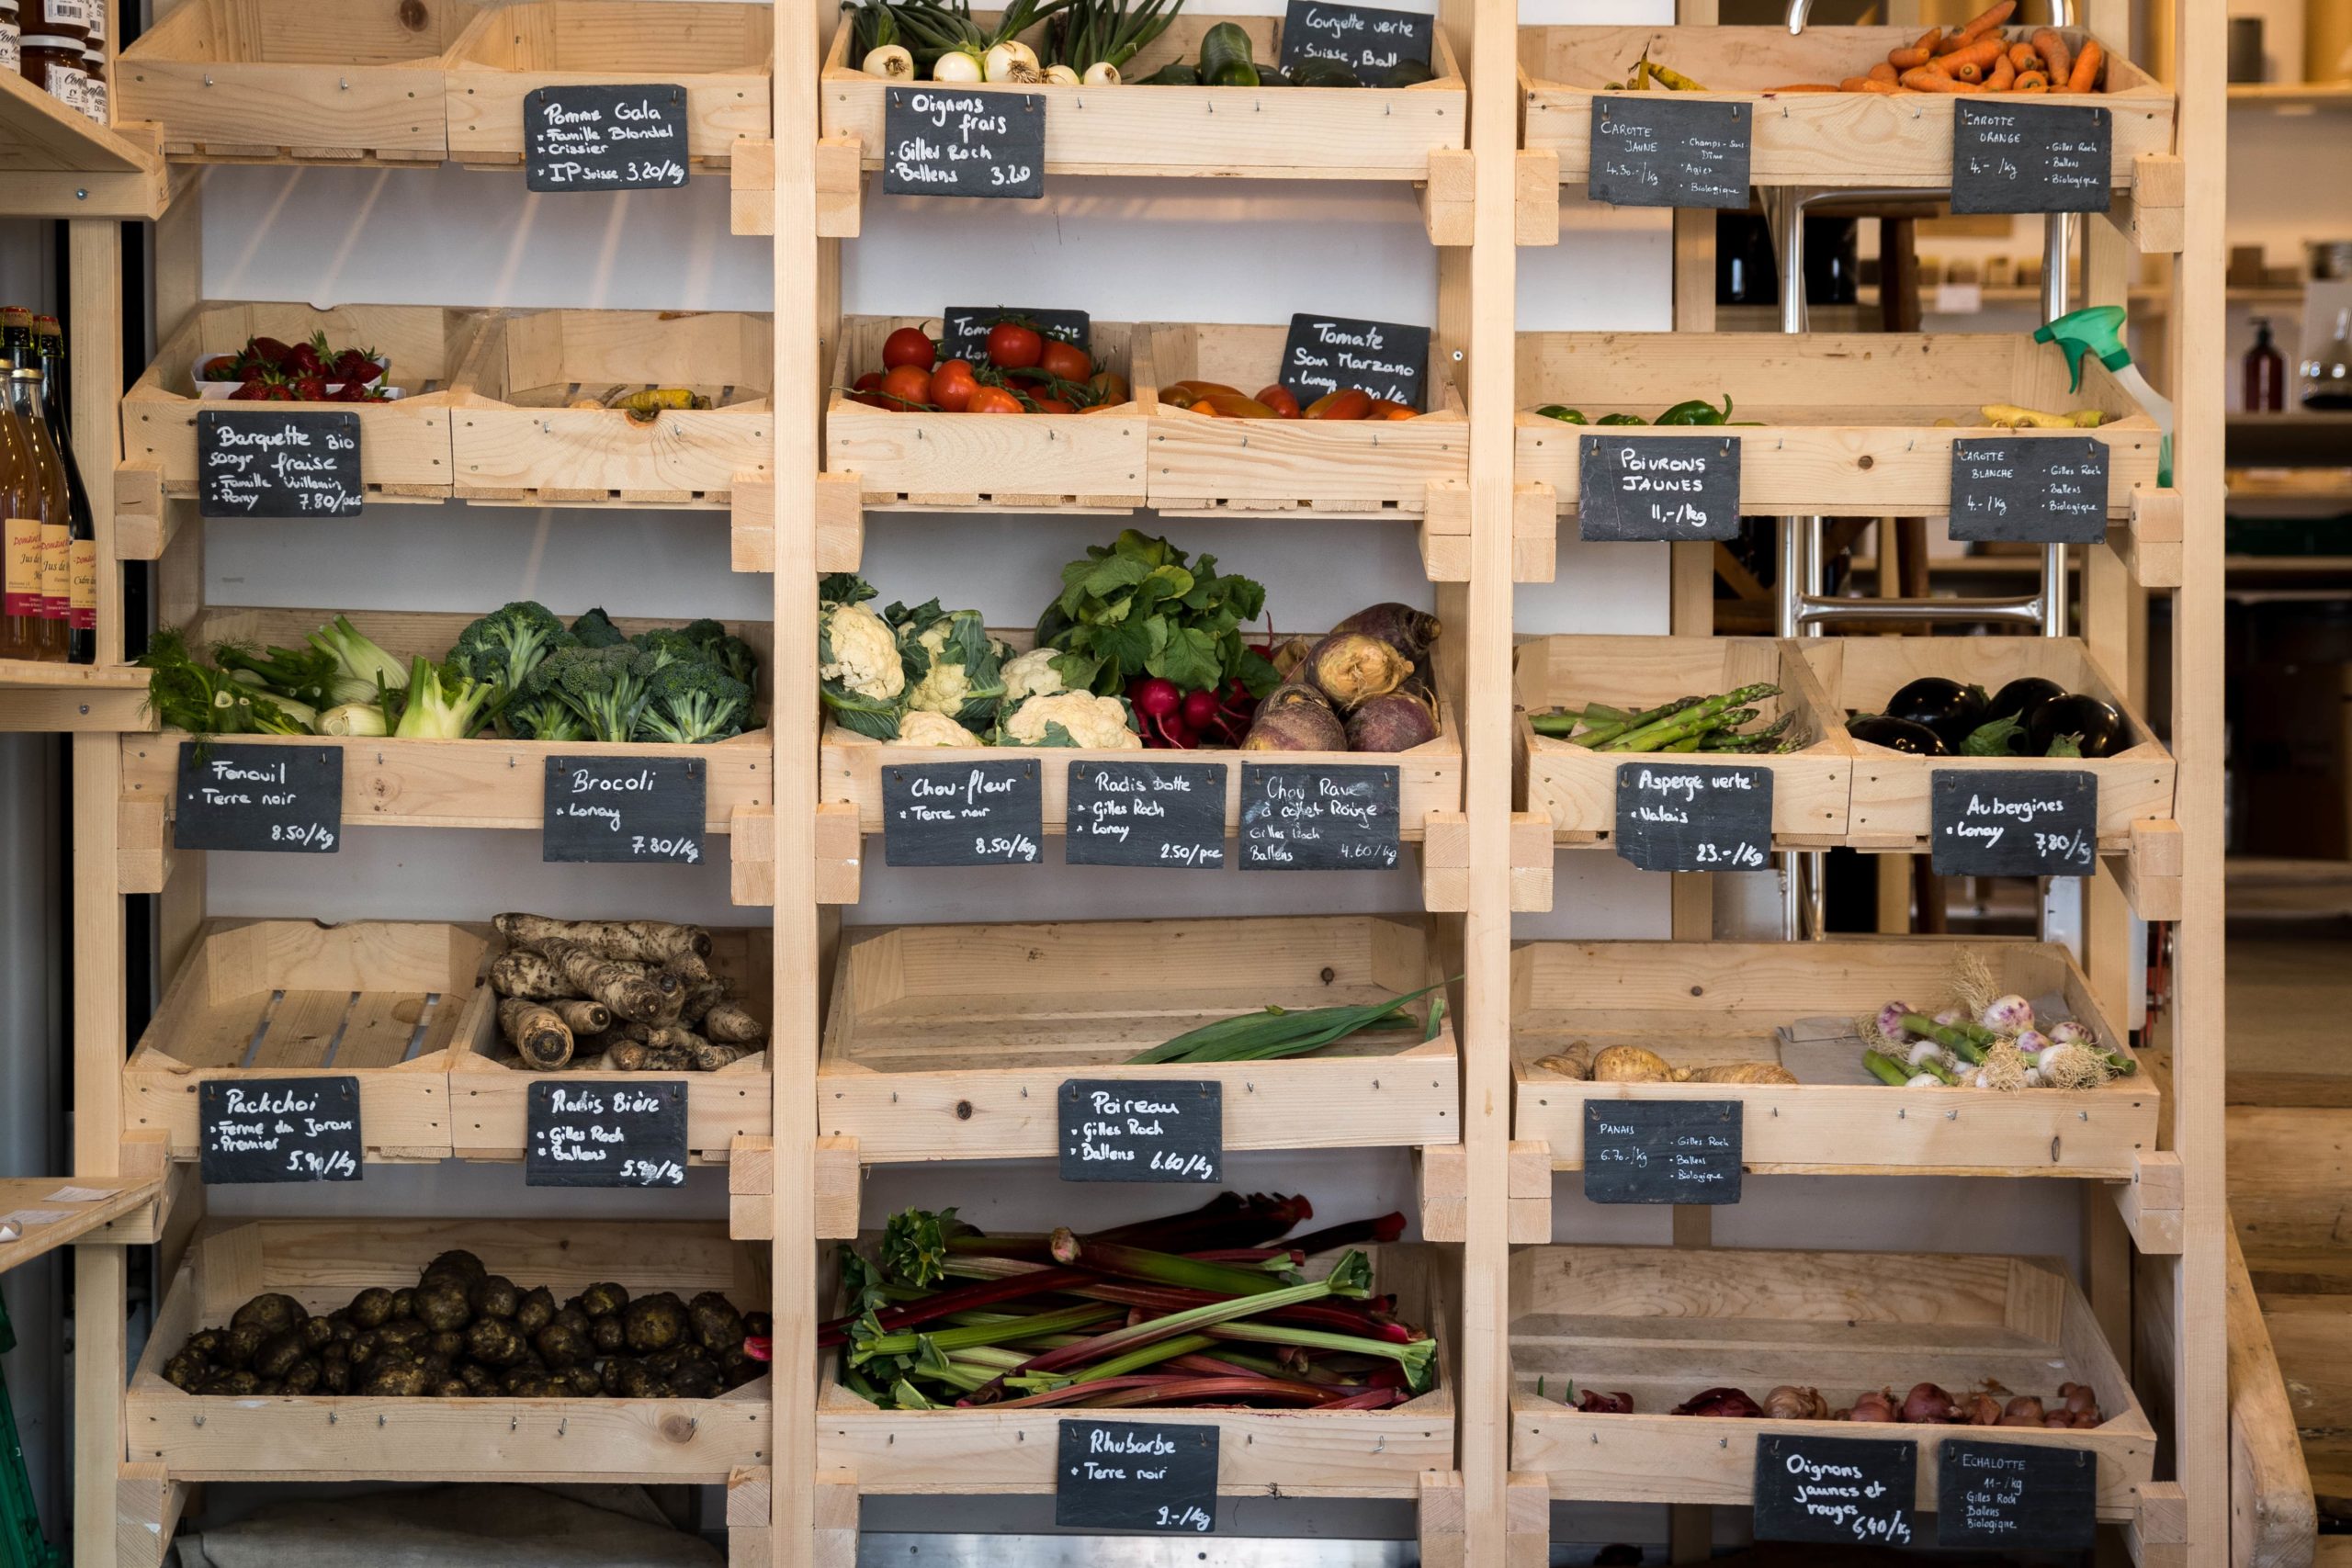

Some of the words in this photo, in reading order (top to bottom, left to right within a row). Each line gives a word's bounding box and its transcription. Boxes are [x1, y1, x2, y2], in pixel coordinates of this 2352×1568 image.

[1306, 7, 1364, 39] Courgette
[1373, 19, 1414, 38] verte
[544, 103, 602, 125] Pomme
[615, 99, 662, 120] Gala
[911, 94, 984, 127] Oignons
[1966, 113, 2015, 126] CAROTTE
[547, 126, 600, 141] Famille
[607, 124, 673, 141] Blondel
[958, 113, 1007, 144] frais
[1600, 121, 1654, 137] CAROTTE
[1979, 131, 2021, 143] ORANGE
[548, 142, 608, 154] Crissier
[899, 137, 940, 162] Gilles
[1624, 141, 1658, 152] JAUNE
[2052, 142, 2073, 152] Gilles
[2078, 142, 2097, 152] Roch
[548, 162, 582, 182] IP
[990, 164, 1031, 186] 3.20
[2052, 175, 2099, 188] Biologique
[1690, 183, 1739, 198] Biologique
[1313, 322, 1384, 350] Tomate
[1294, 347, 1329, 367] San
[1339, 352, 1415, 377] Marzano
[217, 424, 311, 452] Barquette
[325, 434, 355, 450] Bio
[208, 451, 254, 472] 500gr
[271, 452, 337, 478] fraise
[1961, 451, 2006, 461] CAROTTE
[218, 472, 272, 489] Famille
[1972, 468, 2014, 479] BLANCHE
[2051, 465, 2075, 476] Gilles
[2081, 465, 2101, 475] Roch
[1622, 475, 1703, 491] JAUNES
[220, 488, 259, 511] Pomy
[2050, 500, 2098, 514] Biologique
[211, 761, 286, 784] Fenouil
[571, 768, 657, 793] Brocoli
[1095, 772, 1146, 792] Radis
[1267, 776, 1305, 800] Chou
[1639, 770, 1704, 802] Asperge
[1712, 773, 1752, 791] verte
[201, 788, 252, 805] Terre
[262, 791, 297, 805] noir
[569, 803, 621, 832] Lonay
[910, 805, 956, 820] Terre
[961, 807, 990, 818] noir
[1092, 799, 1127, 822] Gilles
[1133, 798, 1165, 817] Roch
[1330, 799, 1378, 830] Rouge
[1639, 805, 1689, 824] Valais
[1966, 794, 2064, 823] Aubergines
[1092, 822, 1130, 843] Lonay
[1250, 825, 1284, 840] Gilles
[1957, 821, 2005, 849] Lonay
[1250, 844, 1294, 862] Ballens
[226, 1088, 320, 1114] Packchoi
[551, 1089, 604, 1114] Radis
[1090, 1090, 1181, 1114] Poireau
[219, 1120, 264, 1135] Ferme
[549, 1125, 586, 1146] Gilles
[1082, 1122, 1122, 1143] Gilles
[1126, 1118, 1164, 1135] Roch
[1678, 1136, 1702, 1146] Gilles
[1708, 1136, 1729, 1146] Roch
[1676, 1155, 1706, 1166] Ballens
[1678, 1169, 1724, 1183] Biologique
[1090, 1428, 1176, 1456] Rhubarbe
[1083, 1461, 1126, 1480] Terre
[1136, 1467, 1168, 1480] noir
[1786, 1454, 1863, 1482] Oignons
[1962, 1453, 2027, 1470] ECHALOTTE
[1863, 1480, 1887, 1498] et
[1966, 1491, 1992, 1504] Gilles
[1806, 1504, 1859, 1525] rouges
[1967, 1518, 2018, 1534] Biologique
